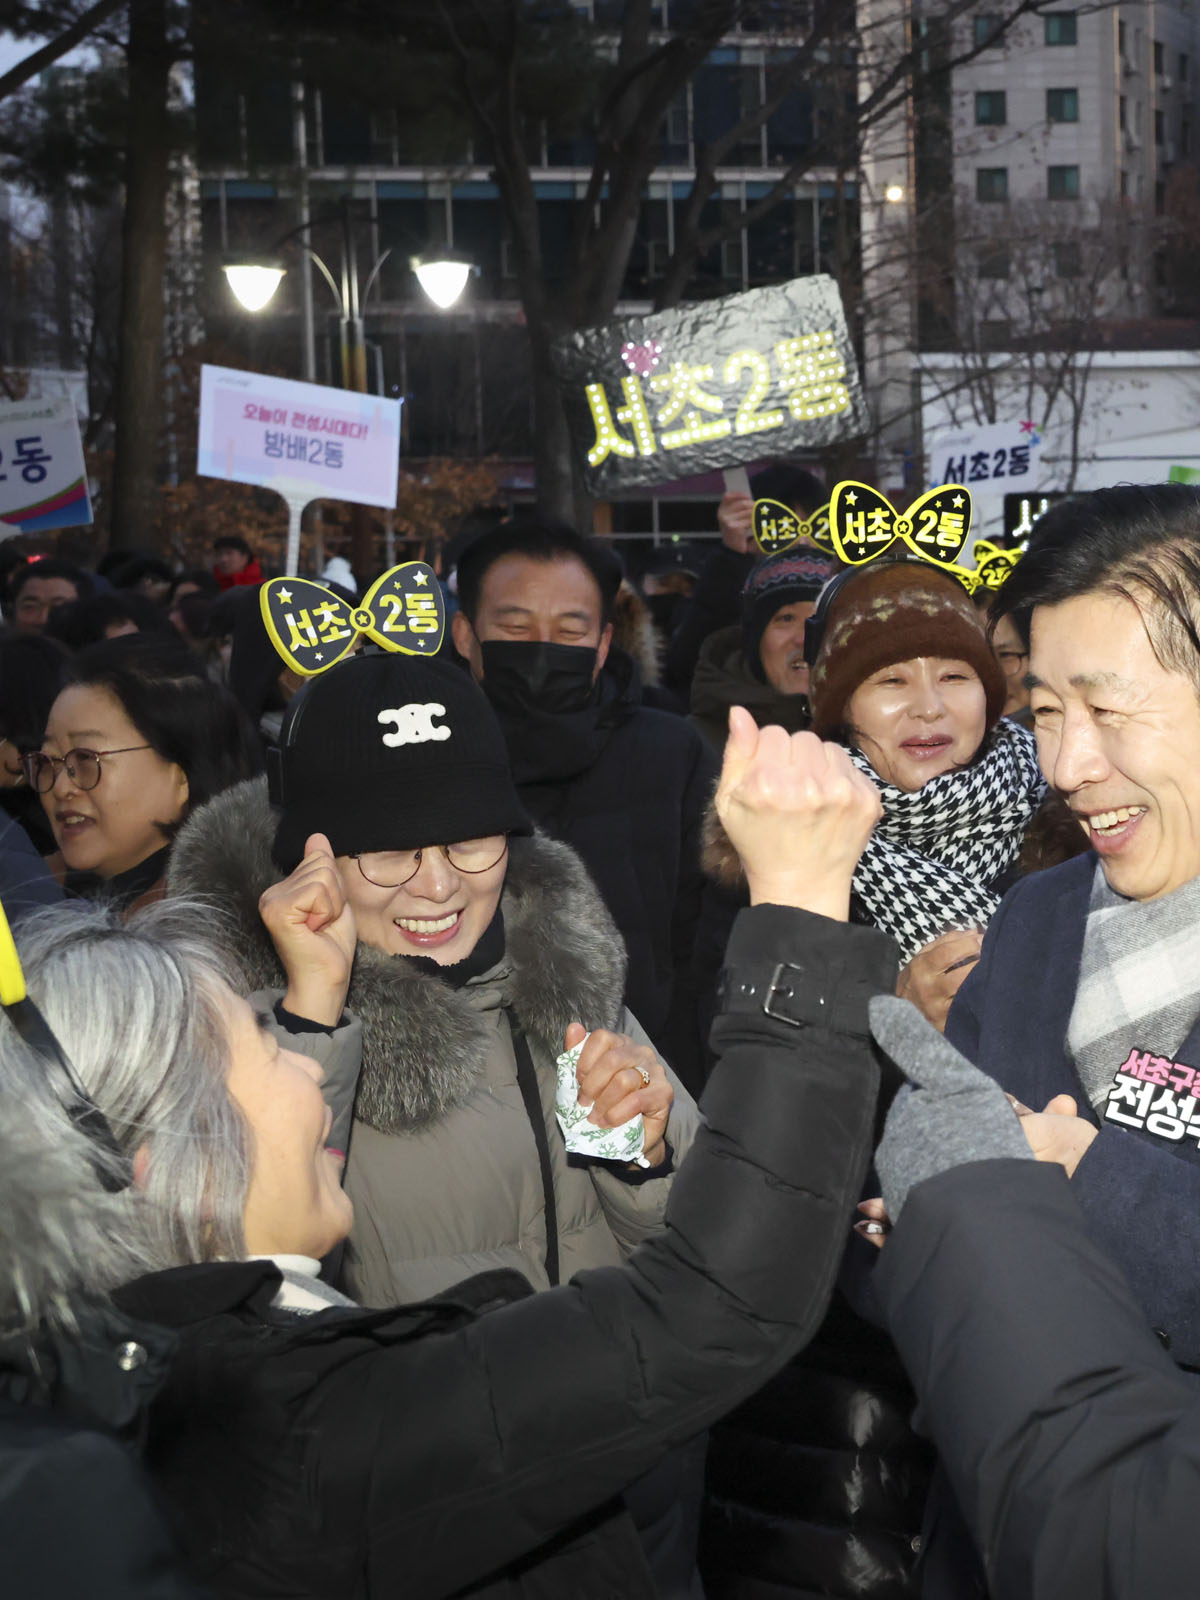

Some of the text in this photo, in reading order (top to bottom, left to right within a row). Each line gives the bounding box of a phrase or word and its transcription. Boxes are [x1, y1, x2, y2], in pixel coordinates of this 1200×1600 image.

[585, 330, 851, 467] 서초2동
[242, 403, 369, 440] 오늘이 전성시대다!
[264, 430, 344, 469] 방배2동
[943, 445, 1031, 484] 서초2동
[760, 516, 830, 542] 서초 2
[842, 507, 965, 548] 서초 2동
[284, 593, 438, 652] 서초 2동
